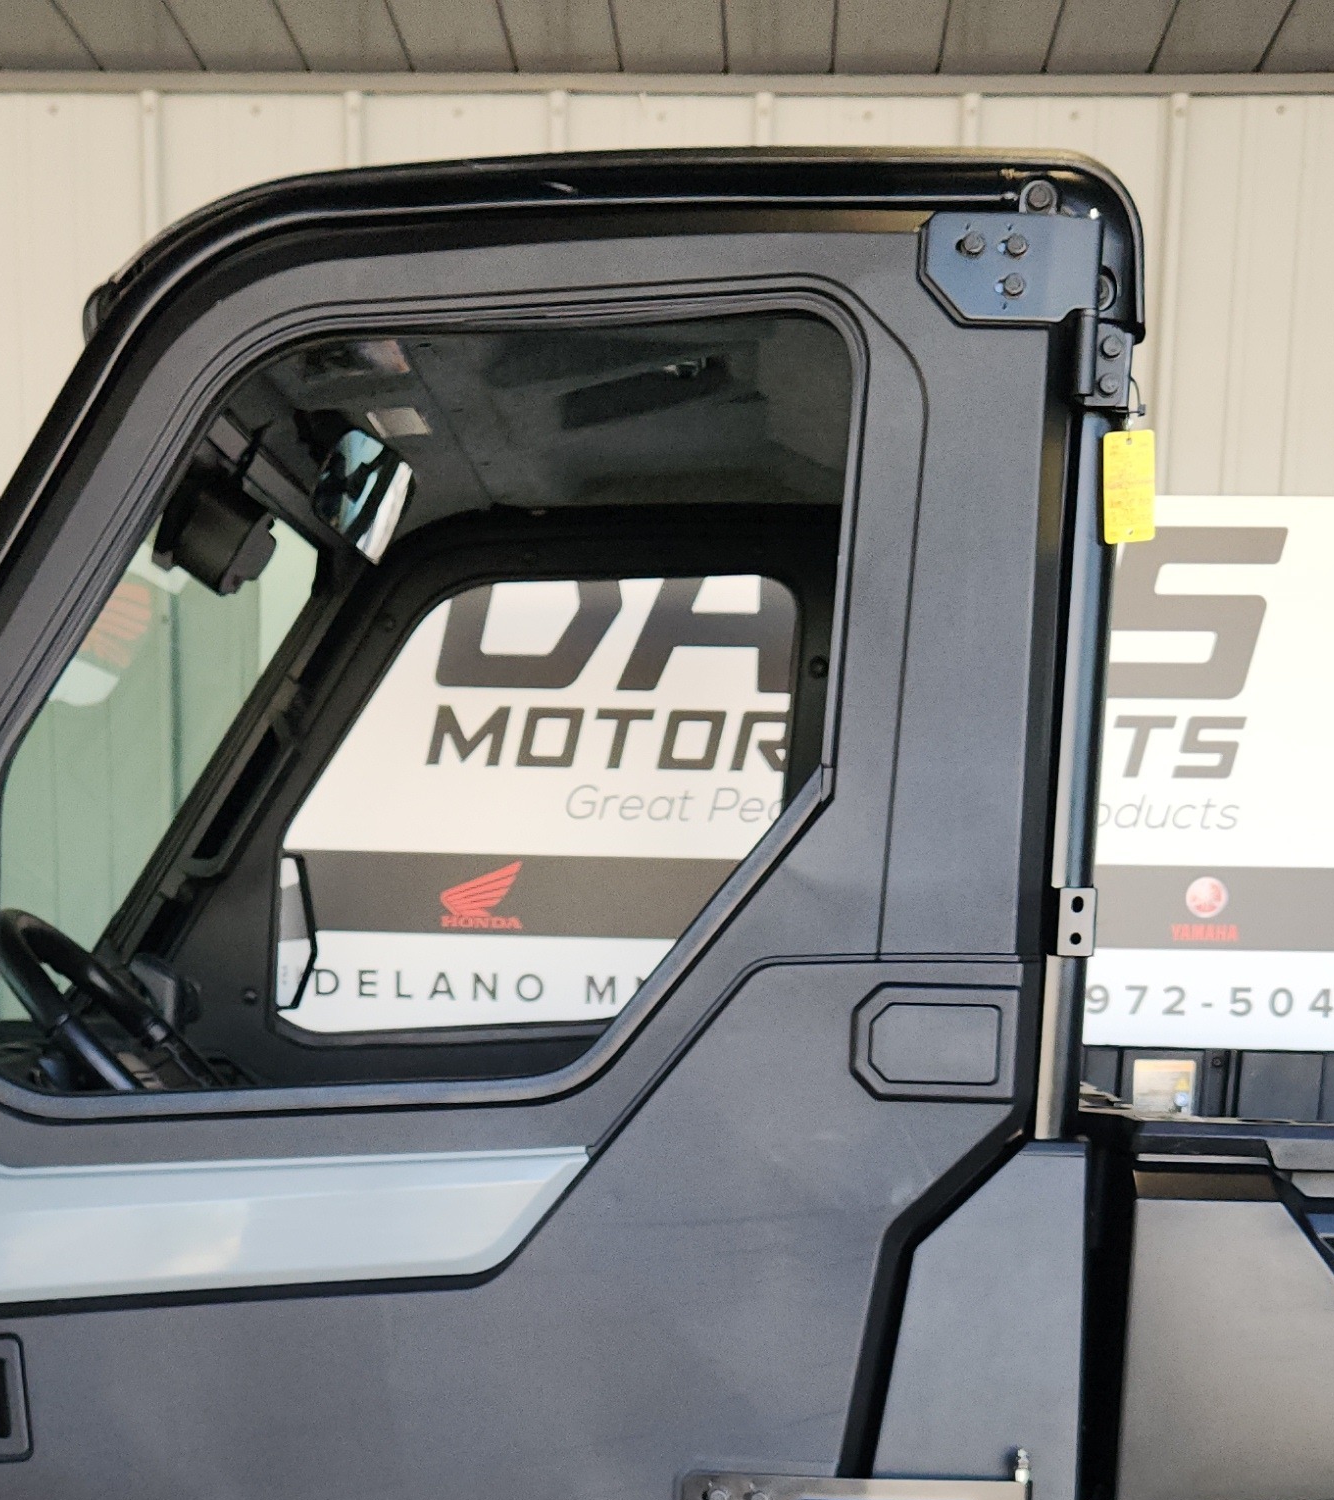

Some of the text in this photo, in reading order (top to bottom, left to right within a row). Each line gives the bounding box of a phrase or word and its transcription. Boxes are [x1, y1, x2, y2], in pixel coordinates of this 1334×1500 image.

[565, 784, 694, 822] Great
[441, 915, 523, 930] HONDA
[1171, 922, 1239, 941] YAMAHA
[316, 968, 545, 1002] DELANO
[585, 975, 649, 1006] M
